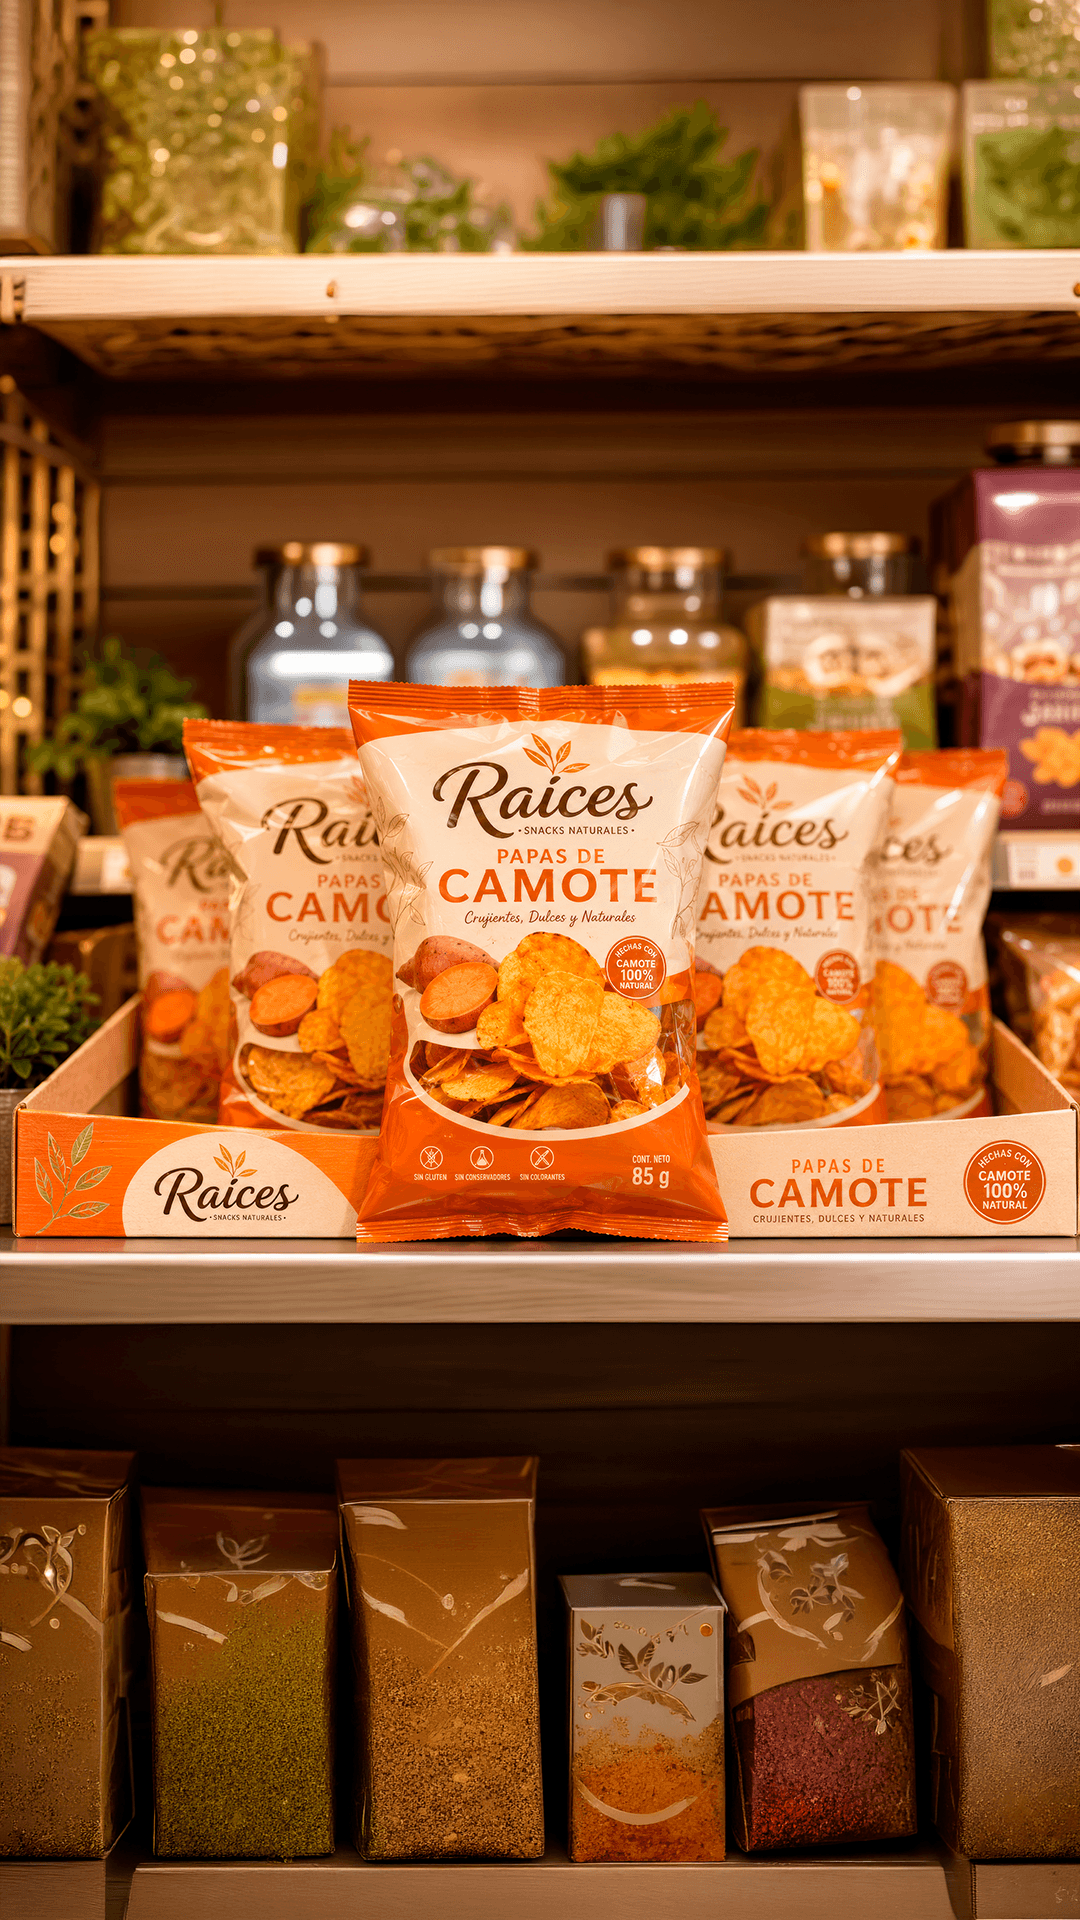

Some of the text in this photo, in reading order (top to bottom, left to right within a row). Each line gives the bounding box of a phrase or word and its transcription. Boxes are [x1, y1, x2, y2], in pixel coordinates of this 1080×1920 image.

[524, 826, 629, 835] SNACKS NATURALES
[497, 848, 605, 864] PAPAS DE
[317, 874, 381, 888] PAPAS
[438, 868, 658, 903] CAMOTE
[718, 873, 813, 887] PAPAS DE
[464, 909, 636, 928] Crujientes, Dulces y Naturales
[615, 942, 658, 958] HECHAS CON
[616, 959, 656, 968] CAMOTE
[620, 969, 654, 981] 100%
[619, 982, 654, 990] NATURAL
[632, 1154, 671, 1164] CONT. NETO
[977, 1149, 1033, 1168] HECHAS CON
[791, 1158, 885, 1174] PAPAS DE
[413, 1173, 447, 1181] SIN GLUTEN
[454, 1173, 511, 1181] SIN CONSERVADORES
[519, 1173, 565, 1181] SIN COLORANTES
[632, 1166, 670, 1189] 85 g
[978, 1170, 1031, 1181] CAMOTE
[750, 1177, 928, 1208] CAMOTE
[983, 1182, 1028, 1199] 100%
[982, 1200, 1028, 1210] NATURAL
[753, 1213, 925, 1223] CRUJIENTES, DULCES Y NATURALES
